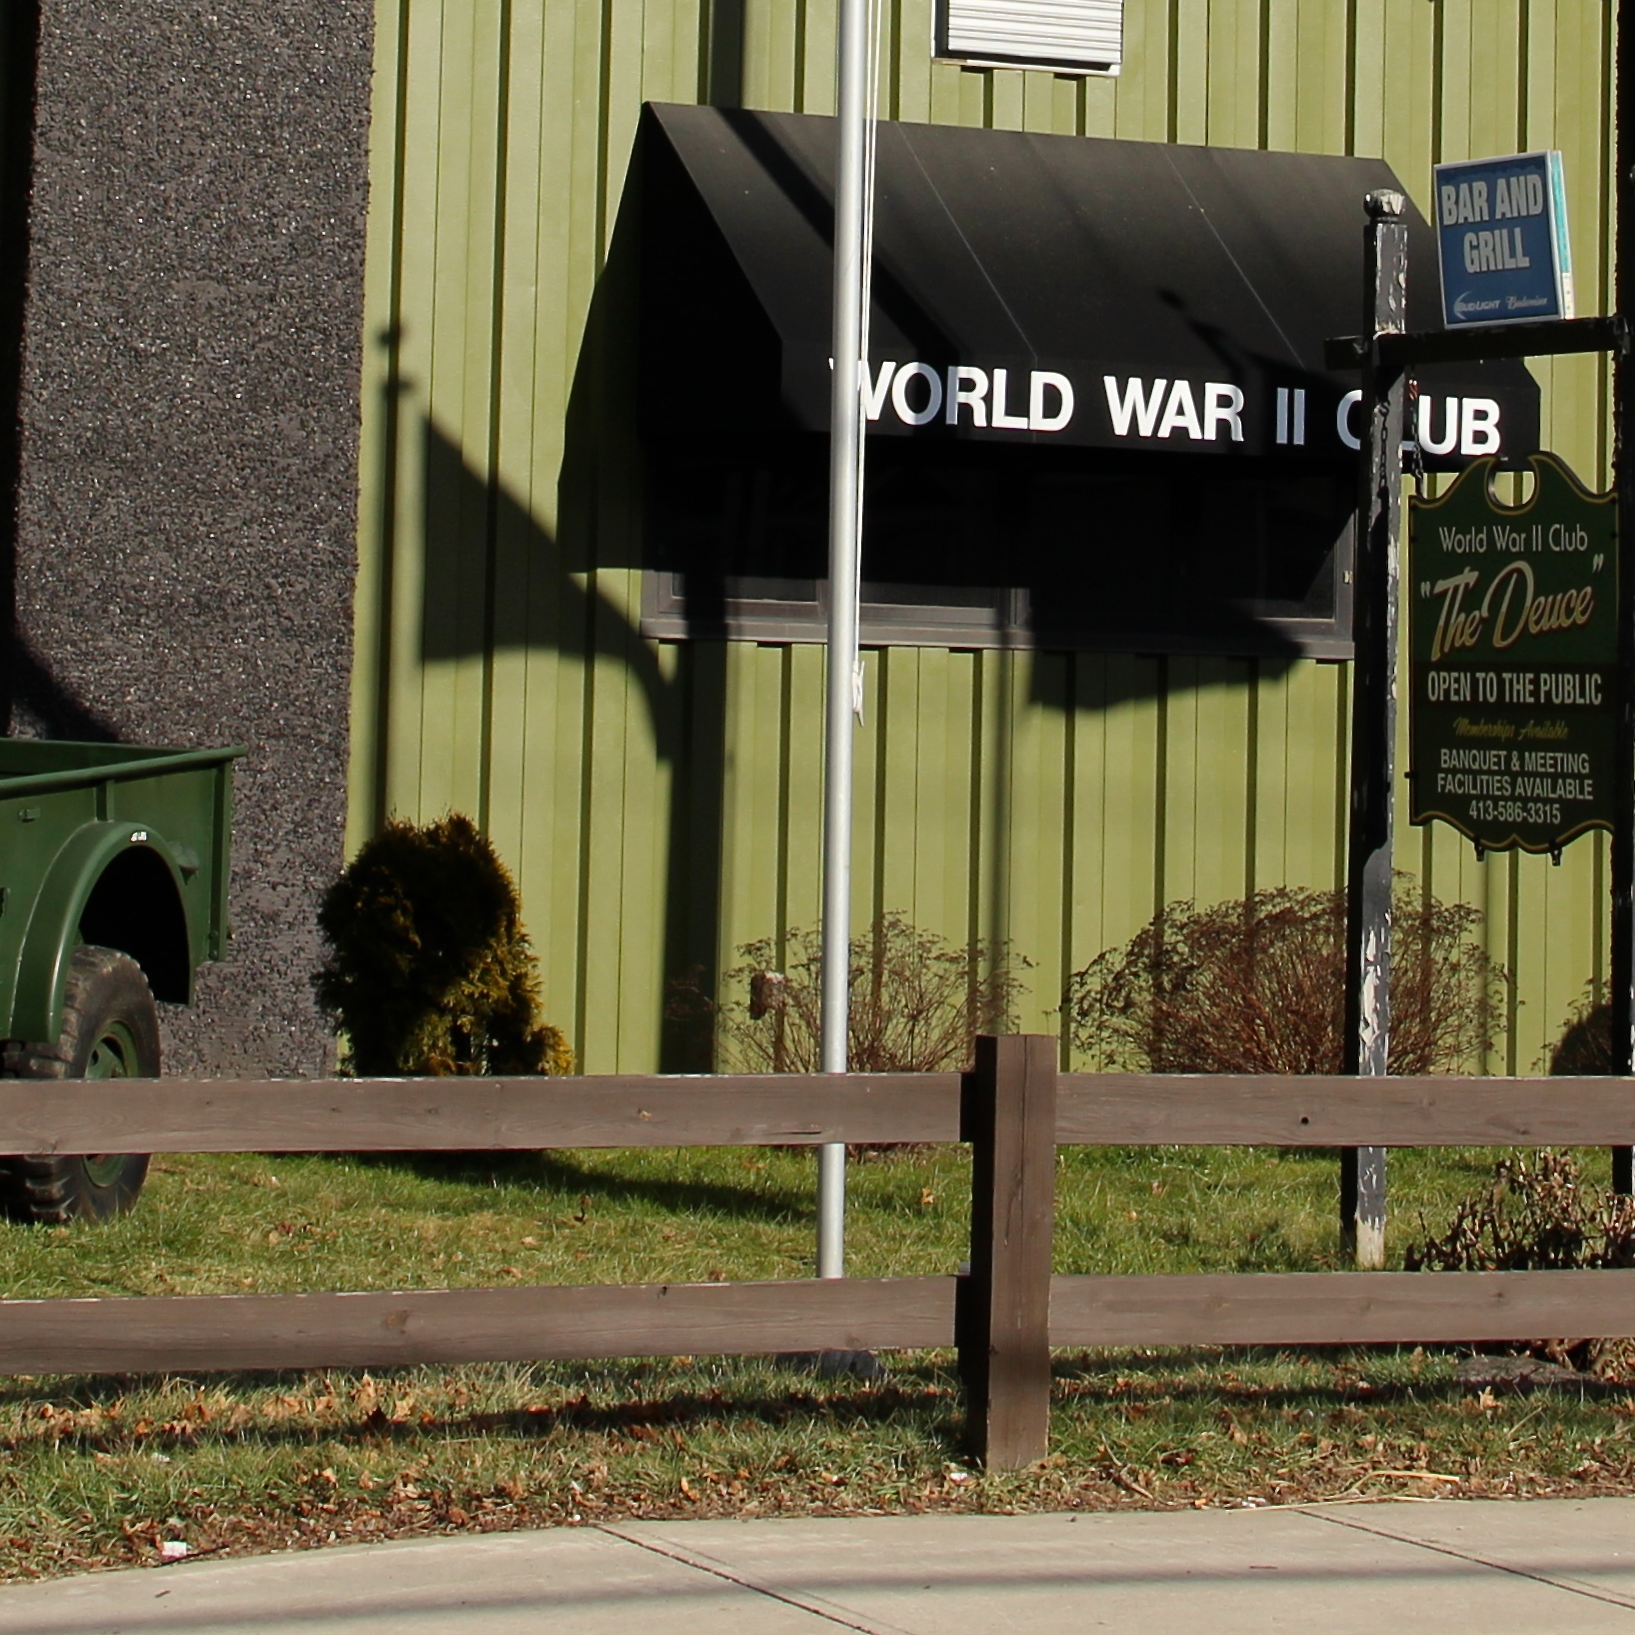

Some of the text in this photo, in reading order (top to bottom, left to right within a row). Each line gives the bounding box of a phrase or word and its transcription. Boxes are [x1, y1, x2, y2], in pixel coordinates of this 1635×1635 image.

[1441, 174, 1544, 226] BAR AND
[1463, 227, 1530, 274] GRILL
[829, 358, 1502, 456] WORLD WAR II CUB
[1439, 523, 1588, 553] World War II Club
[1427, 671, 1602, 705] OPEN TO THE PUBLIC
[1453, 717, 1569, 743] Memberships Available
[1440, 748, 1590, 774] BANQUET & MEETING
[1437, 773, 1594, 800] FACILITIES AVAILABLE
[1469, 799, 1561, 825] 413-586-3315
